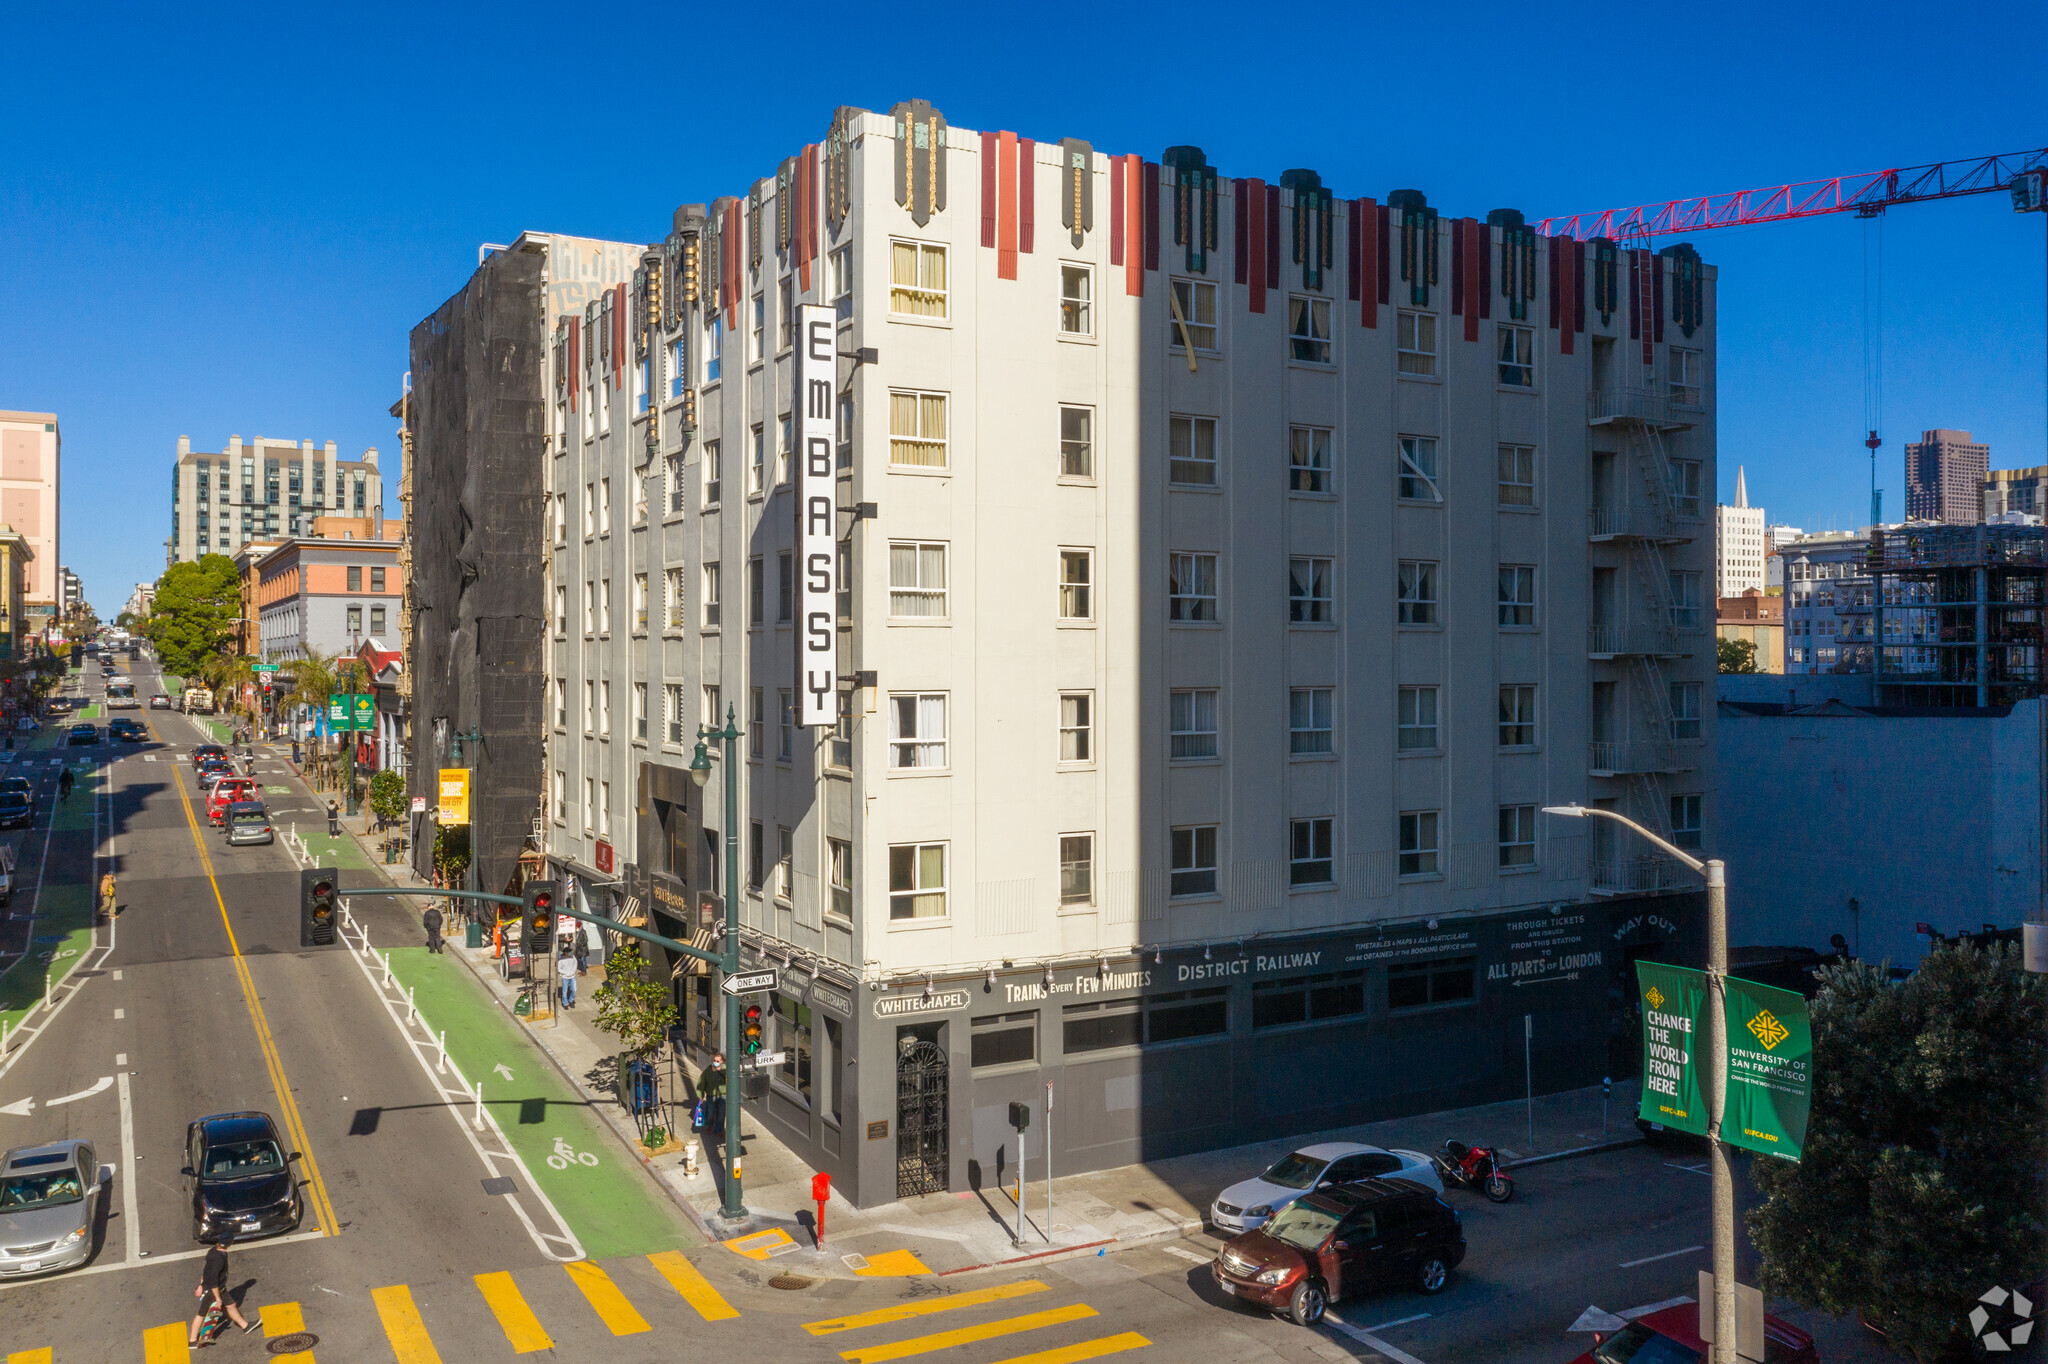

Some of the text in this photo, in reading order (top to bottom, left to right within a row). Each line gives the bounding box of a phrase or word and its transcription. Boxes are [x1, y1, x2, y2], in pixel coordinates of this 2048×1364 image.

[441, 788, 463, 796] JOBS.
[1506, 915, 1585, 931] THROUGH TICKETS
[1613, 914, 1677, 941] WAY OUT
[1355, 940, 1391, 950] TIMETABLES
[1396, 938, 1412, 946] MAPS
[1418, 936, 1429, 944] ALL
[1430, 932, 1469, 942] PARTICULARS
[1363, 950, 1394, 960] OBTAINED
[1411, 946, 1438, 955] BOOKING
[1439, 943, 1460, 952] OFFICE
[1511, 936, 1581, 950] FROM THIS STATION
[1178, 951, 1322, 982] DISTRICT RAILWAY
[1487, 951, 1602, 980] ALL PARTS OF LONDON
[737, 975, 771, 988] ONE WAY
[781, 981, 802, 997] RAILWAY
[1005, 970, 1151, 1003] TRAINS EVERY FEW MINUTES
[813, 986, 849, 1013] WHITECHAPEL
[881, 992, 963, 1015] WHITECHAPEL
[1647, 1010, 1693, 1033] CHANGE
[1648, 1027, 1670, 1045] THE
[755, 1056, 775, 1065] URK
[1649, 1043, 1689, 1065] WORLD
[1731, 1047, 1807, 1070] UNIVERSITY OF
[1648, 1059, 1680, 1080] FROM
[1731, 1058, 1806, 1082] SAN FRANCISCO
[1648, 1075, 1678, 1097] HERE.
[1730, 1074, 1805, 1096] CHANGE THE WORLD FROM HERE
[1659, 1104, 1688, 1119] USFCA.EDU
[1744, 1127, 1779, 1142] USFCA.EDU
